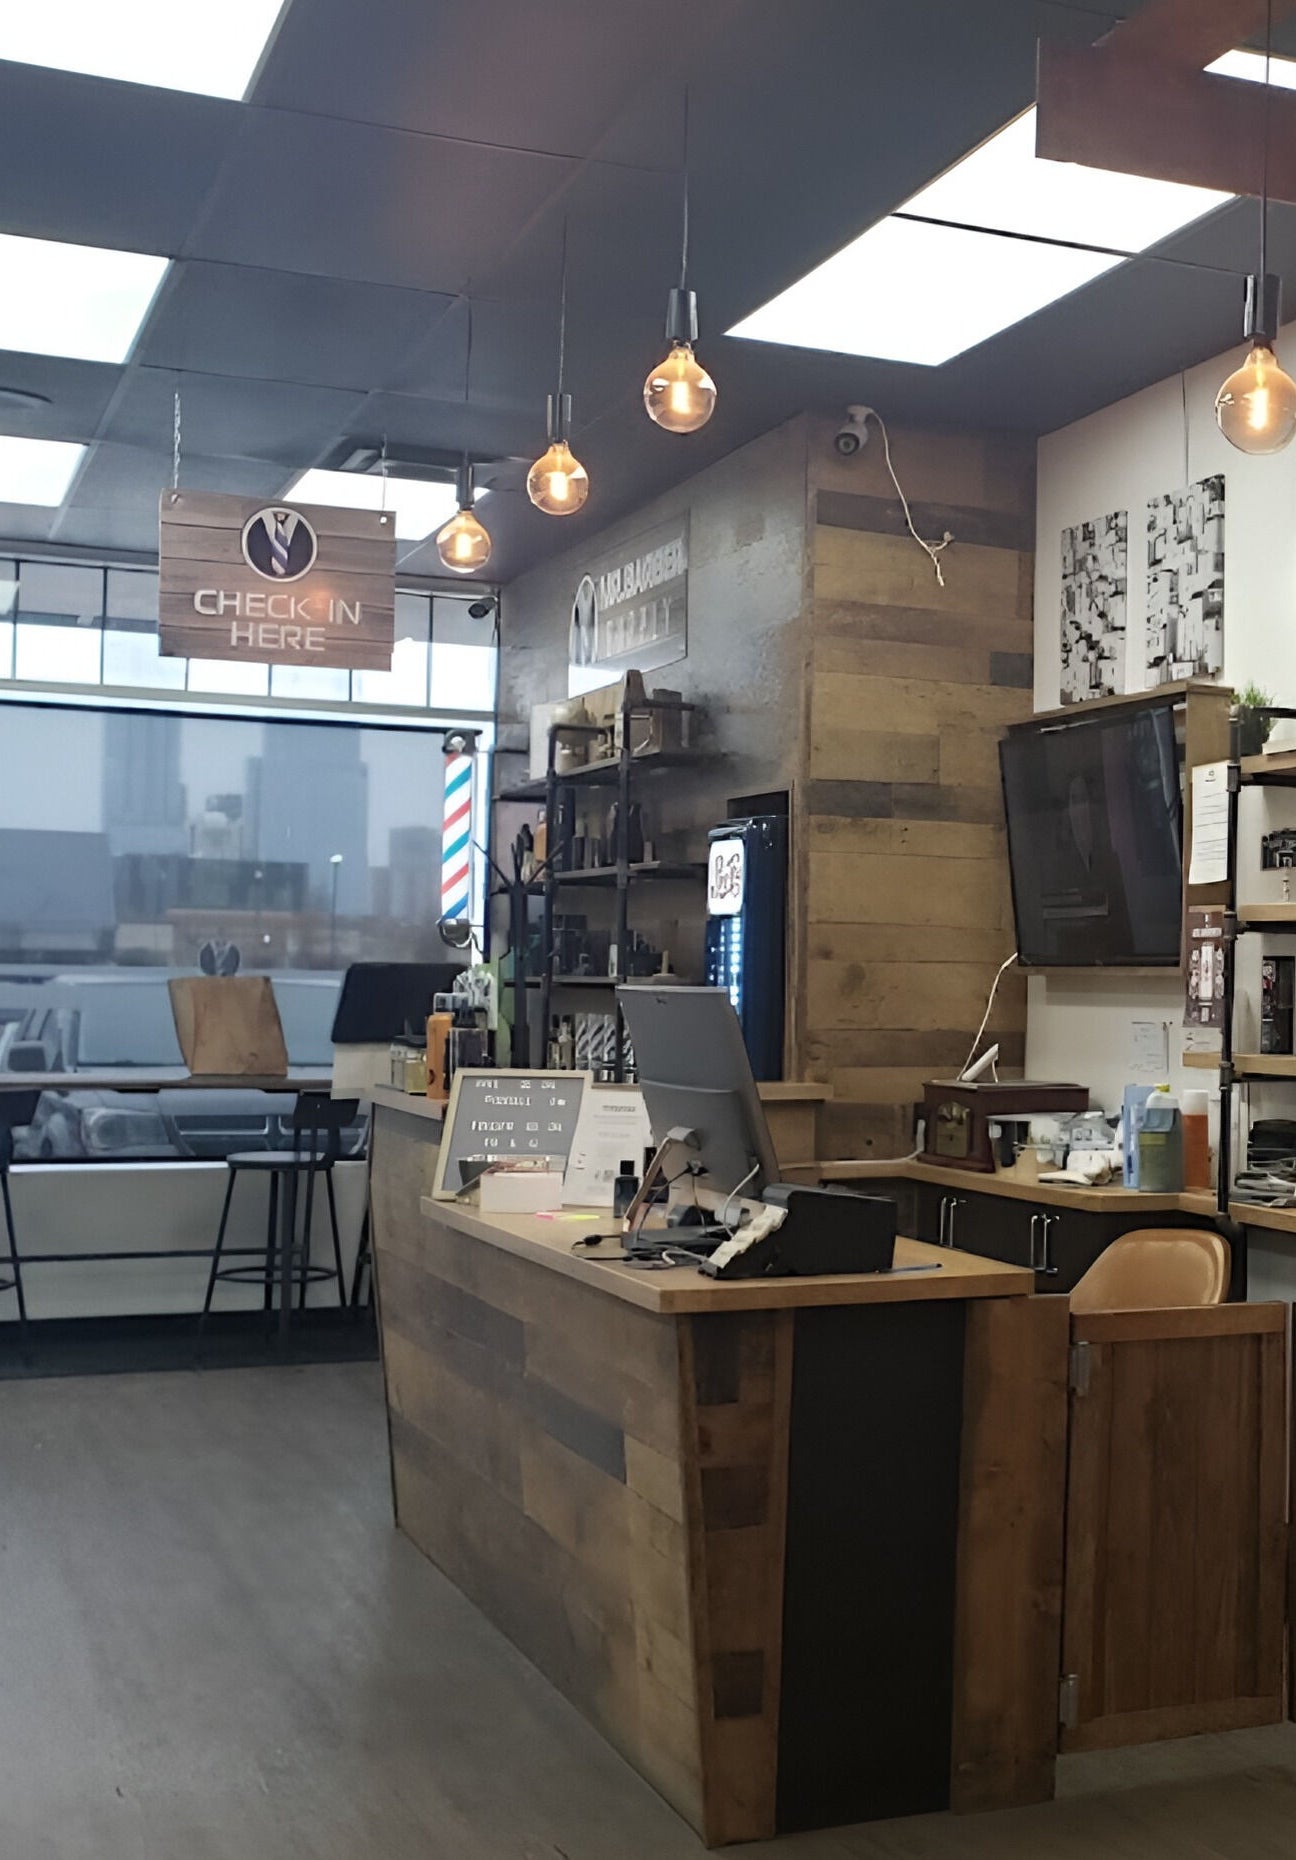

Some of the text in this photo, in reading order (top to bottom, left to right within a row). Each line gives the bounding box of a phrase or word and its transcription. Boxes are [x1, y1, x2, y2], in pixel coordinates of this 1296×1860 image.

[193, 589, 361, 625] CHECK IN
[230, 621, 326, 652] HERE
